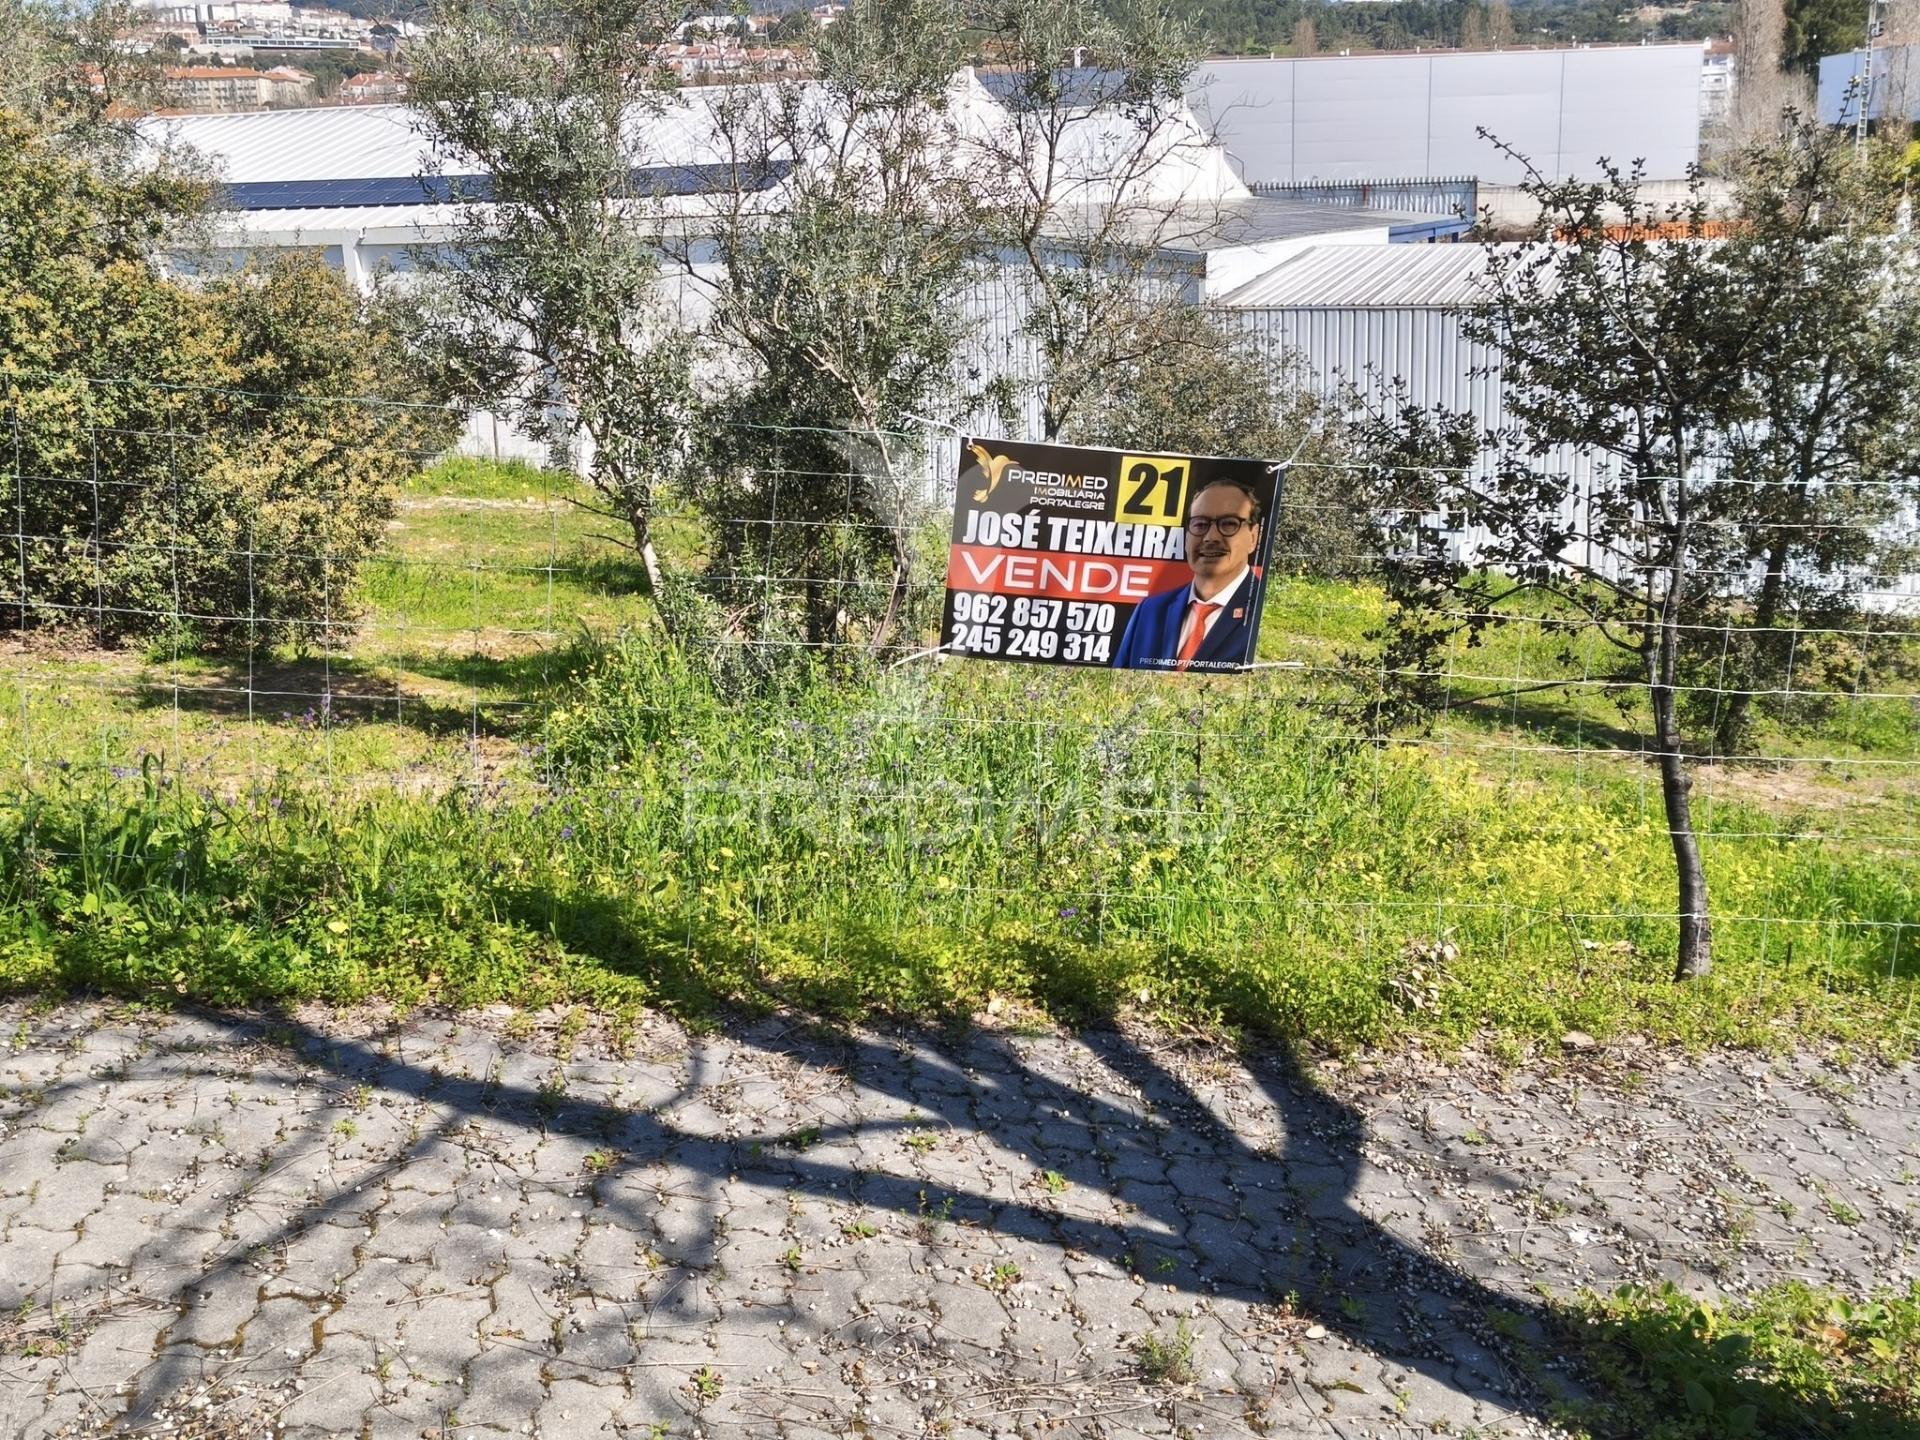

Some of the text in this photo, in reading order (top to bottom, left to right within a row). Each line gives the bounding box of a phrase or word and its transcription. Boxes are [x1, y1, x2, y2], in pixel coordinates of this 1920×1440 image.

[1007, 469, 1109, 490] PREDIMED
[1123, 463, 1184, 517] 21
[1029, 496, 1106, 511] PORTALEGRE
[962, 509, 1185, 560] JOSÉ TEIXEIRA
[961, 551, 1153, 597] VENDE
[952, 592, 1116, 634] 962 857 570
[951, 623, 1111, 663] 245 249 314
